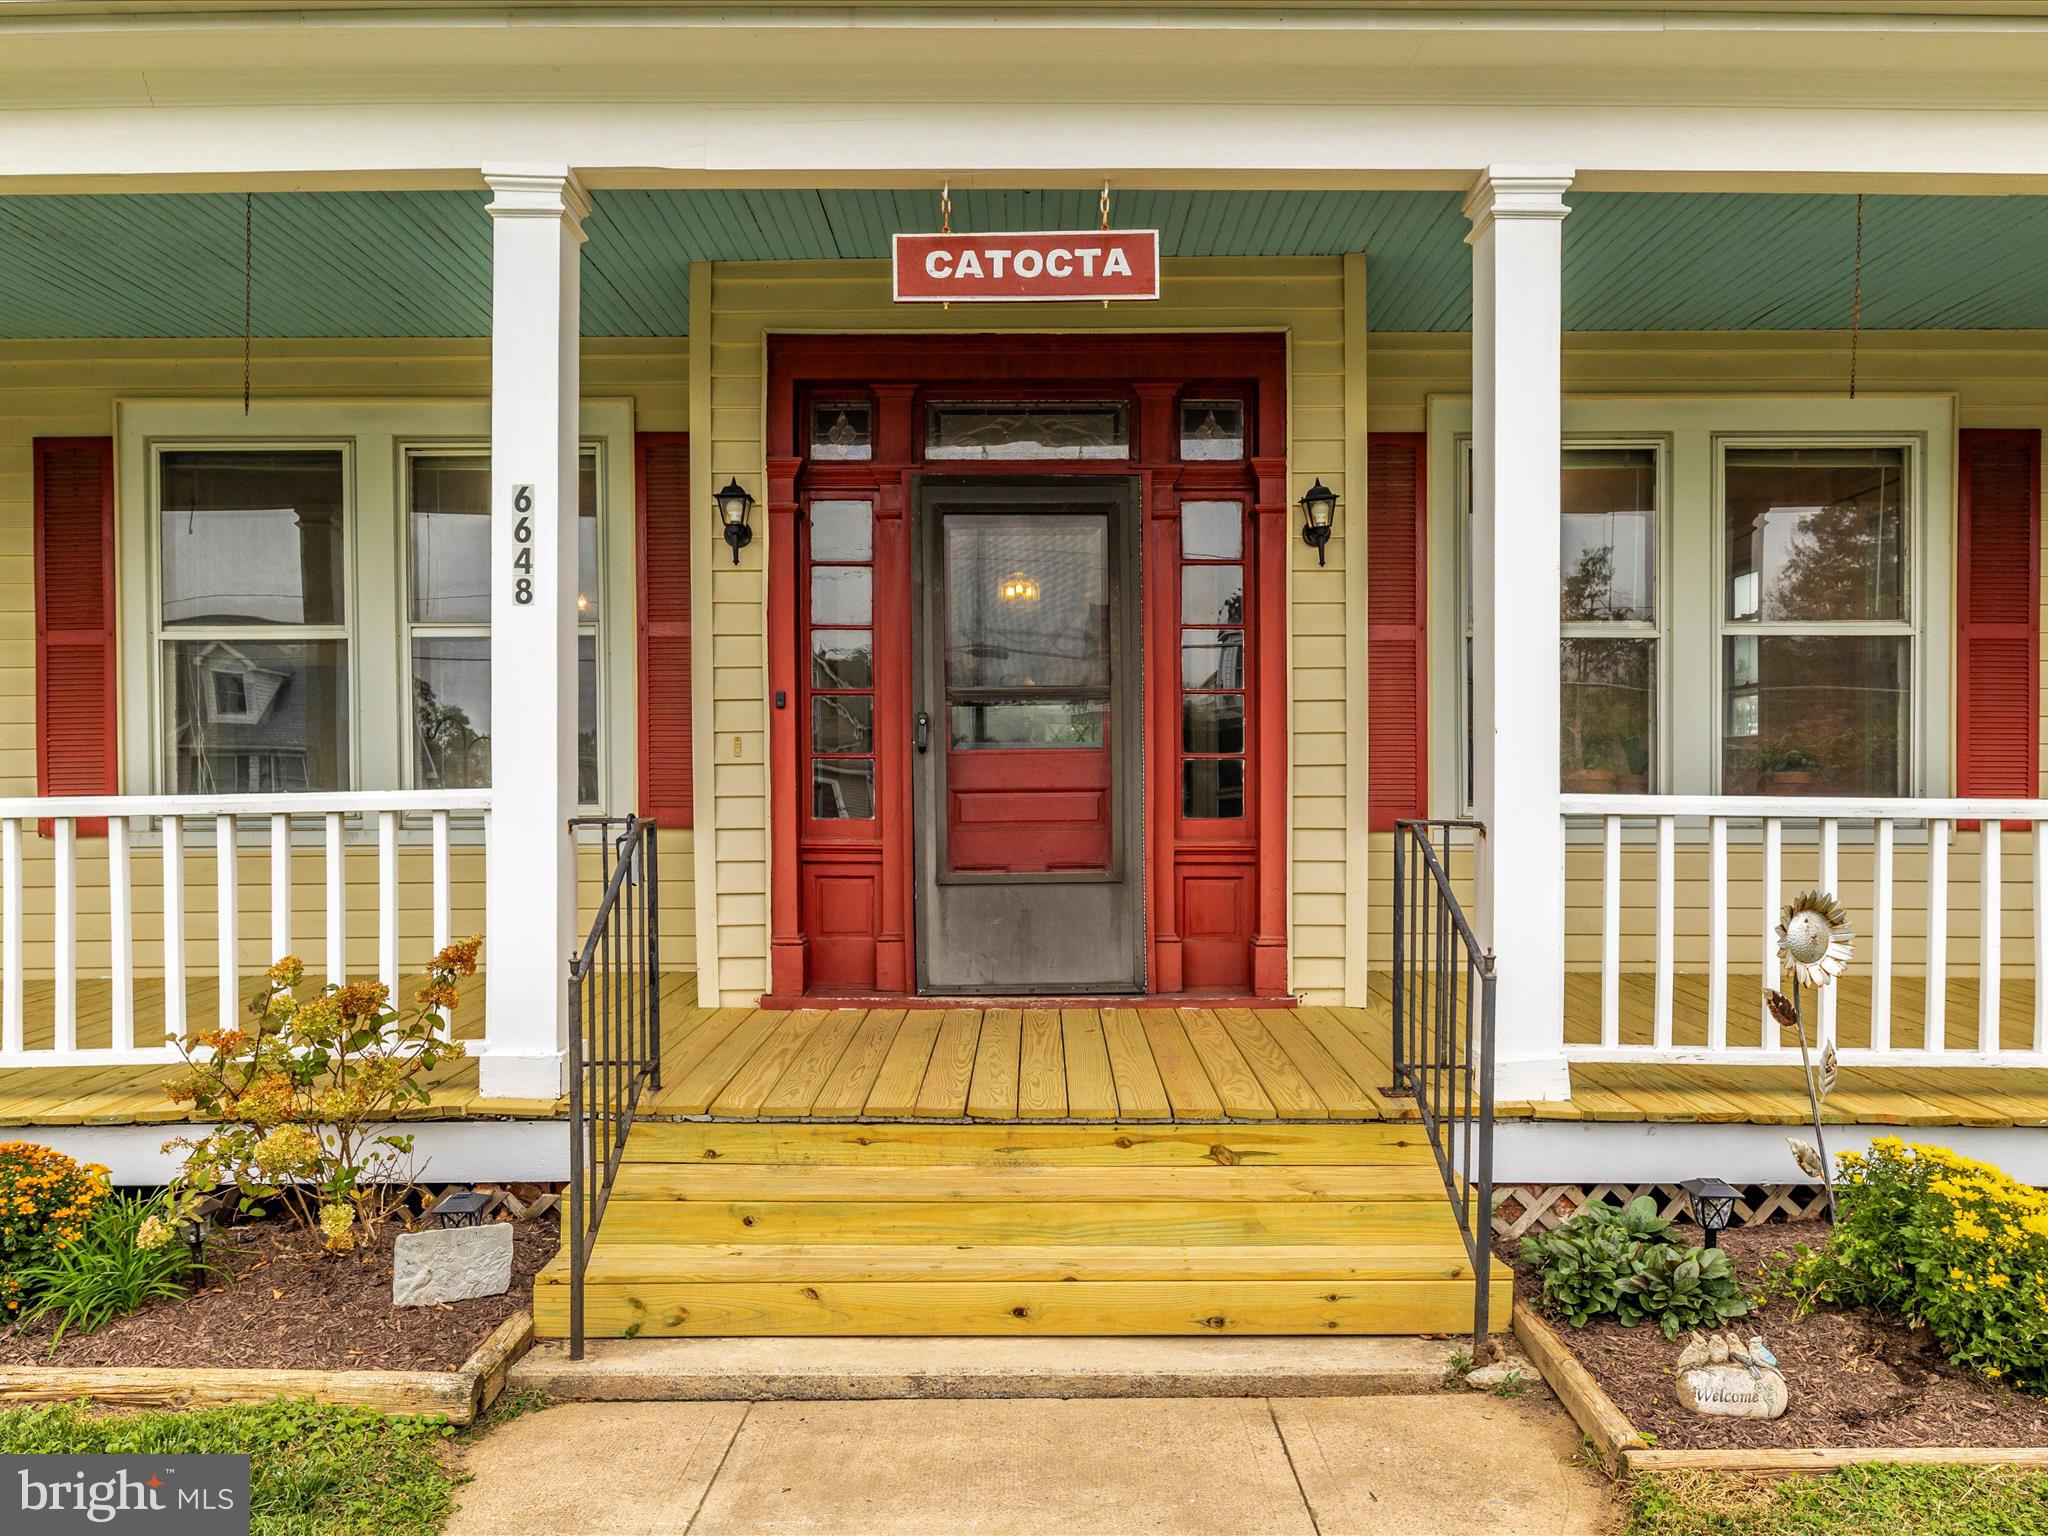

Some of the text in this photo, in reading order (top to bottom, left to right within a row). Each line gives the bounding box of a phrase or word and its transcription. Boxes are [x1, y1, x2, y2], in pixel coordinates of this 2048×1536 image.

[925, 248, 1132, 279] CATOCTA
[513, 485, 534, 605] 6648
[1695, 1386, 1759, 1403] Welcome
